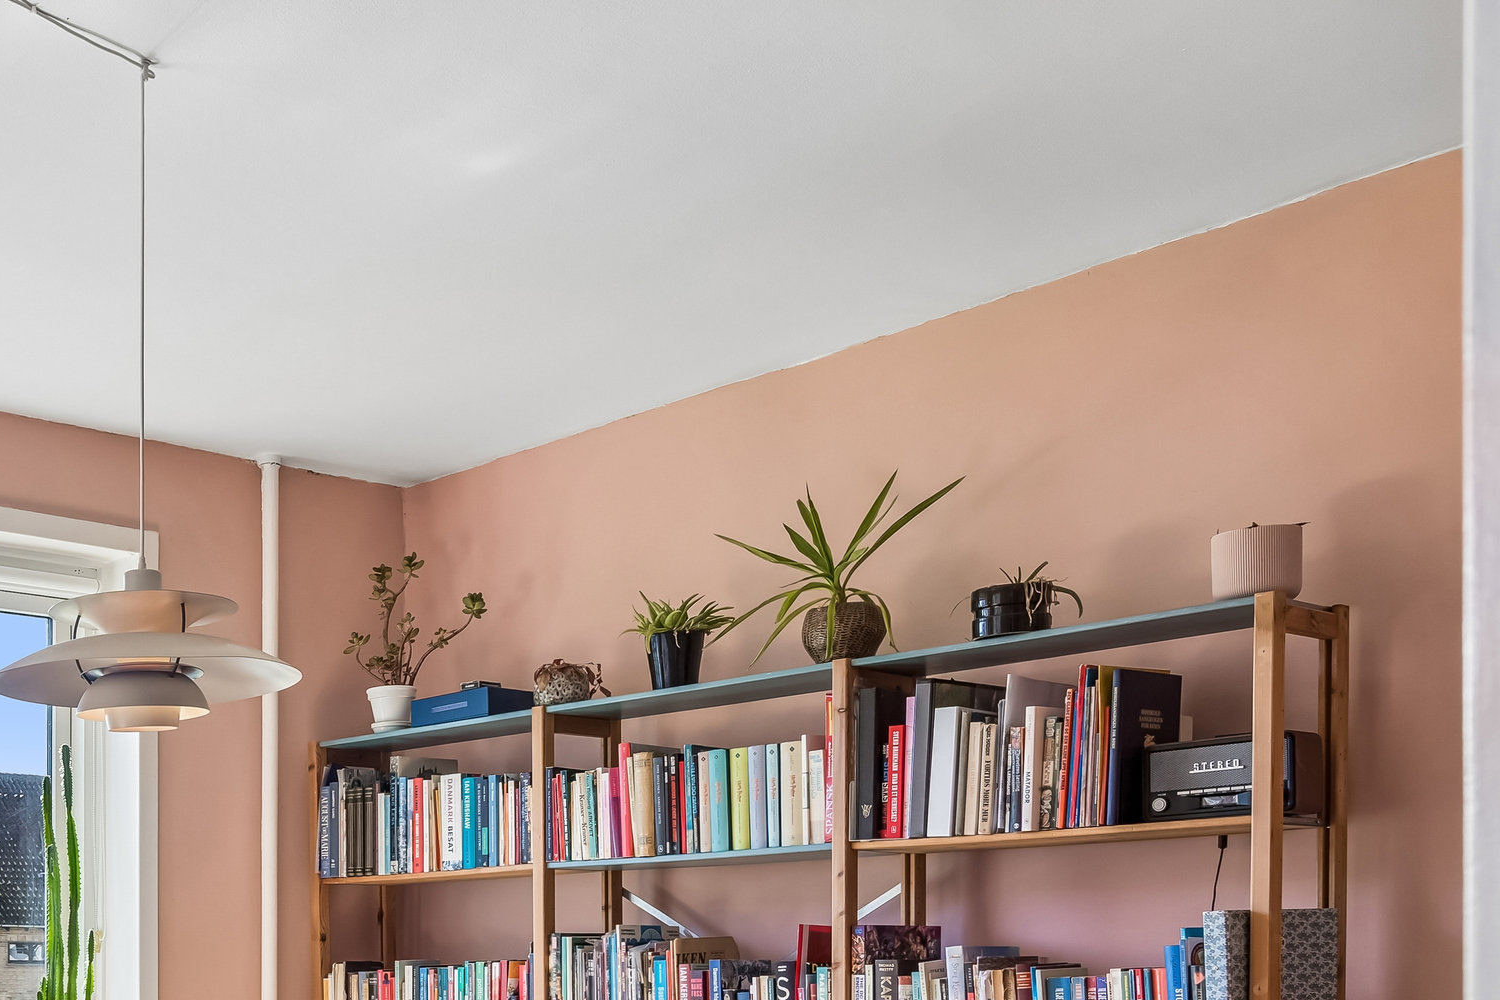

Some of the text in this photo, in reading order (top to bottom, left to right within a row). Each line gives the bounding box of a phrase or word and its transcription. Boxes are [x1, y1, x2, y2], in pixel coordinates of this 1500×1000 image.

[892, 731, 900, 745] SVEND
[891, 746, 899, 772] BRINKMANN
[1193, 758, 1240, 772] STEREO
[983, 760, 993, 788] FORTIDS
[1024, 771, 1032, 804] MATADOR
[825, 783, 833, 834] SPANSK
[320, 796, 329, 859] AUGUST MARIE
[680, 968, 688, 983] IAN
